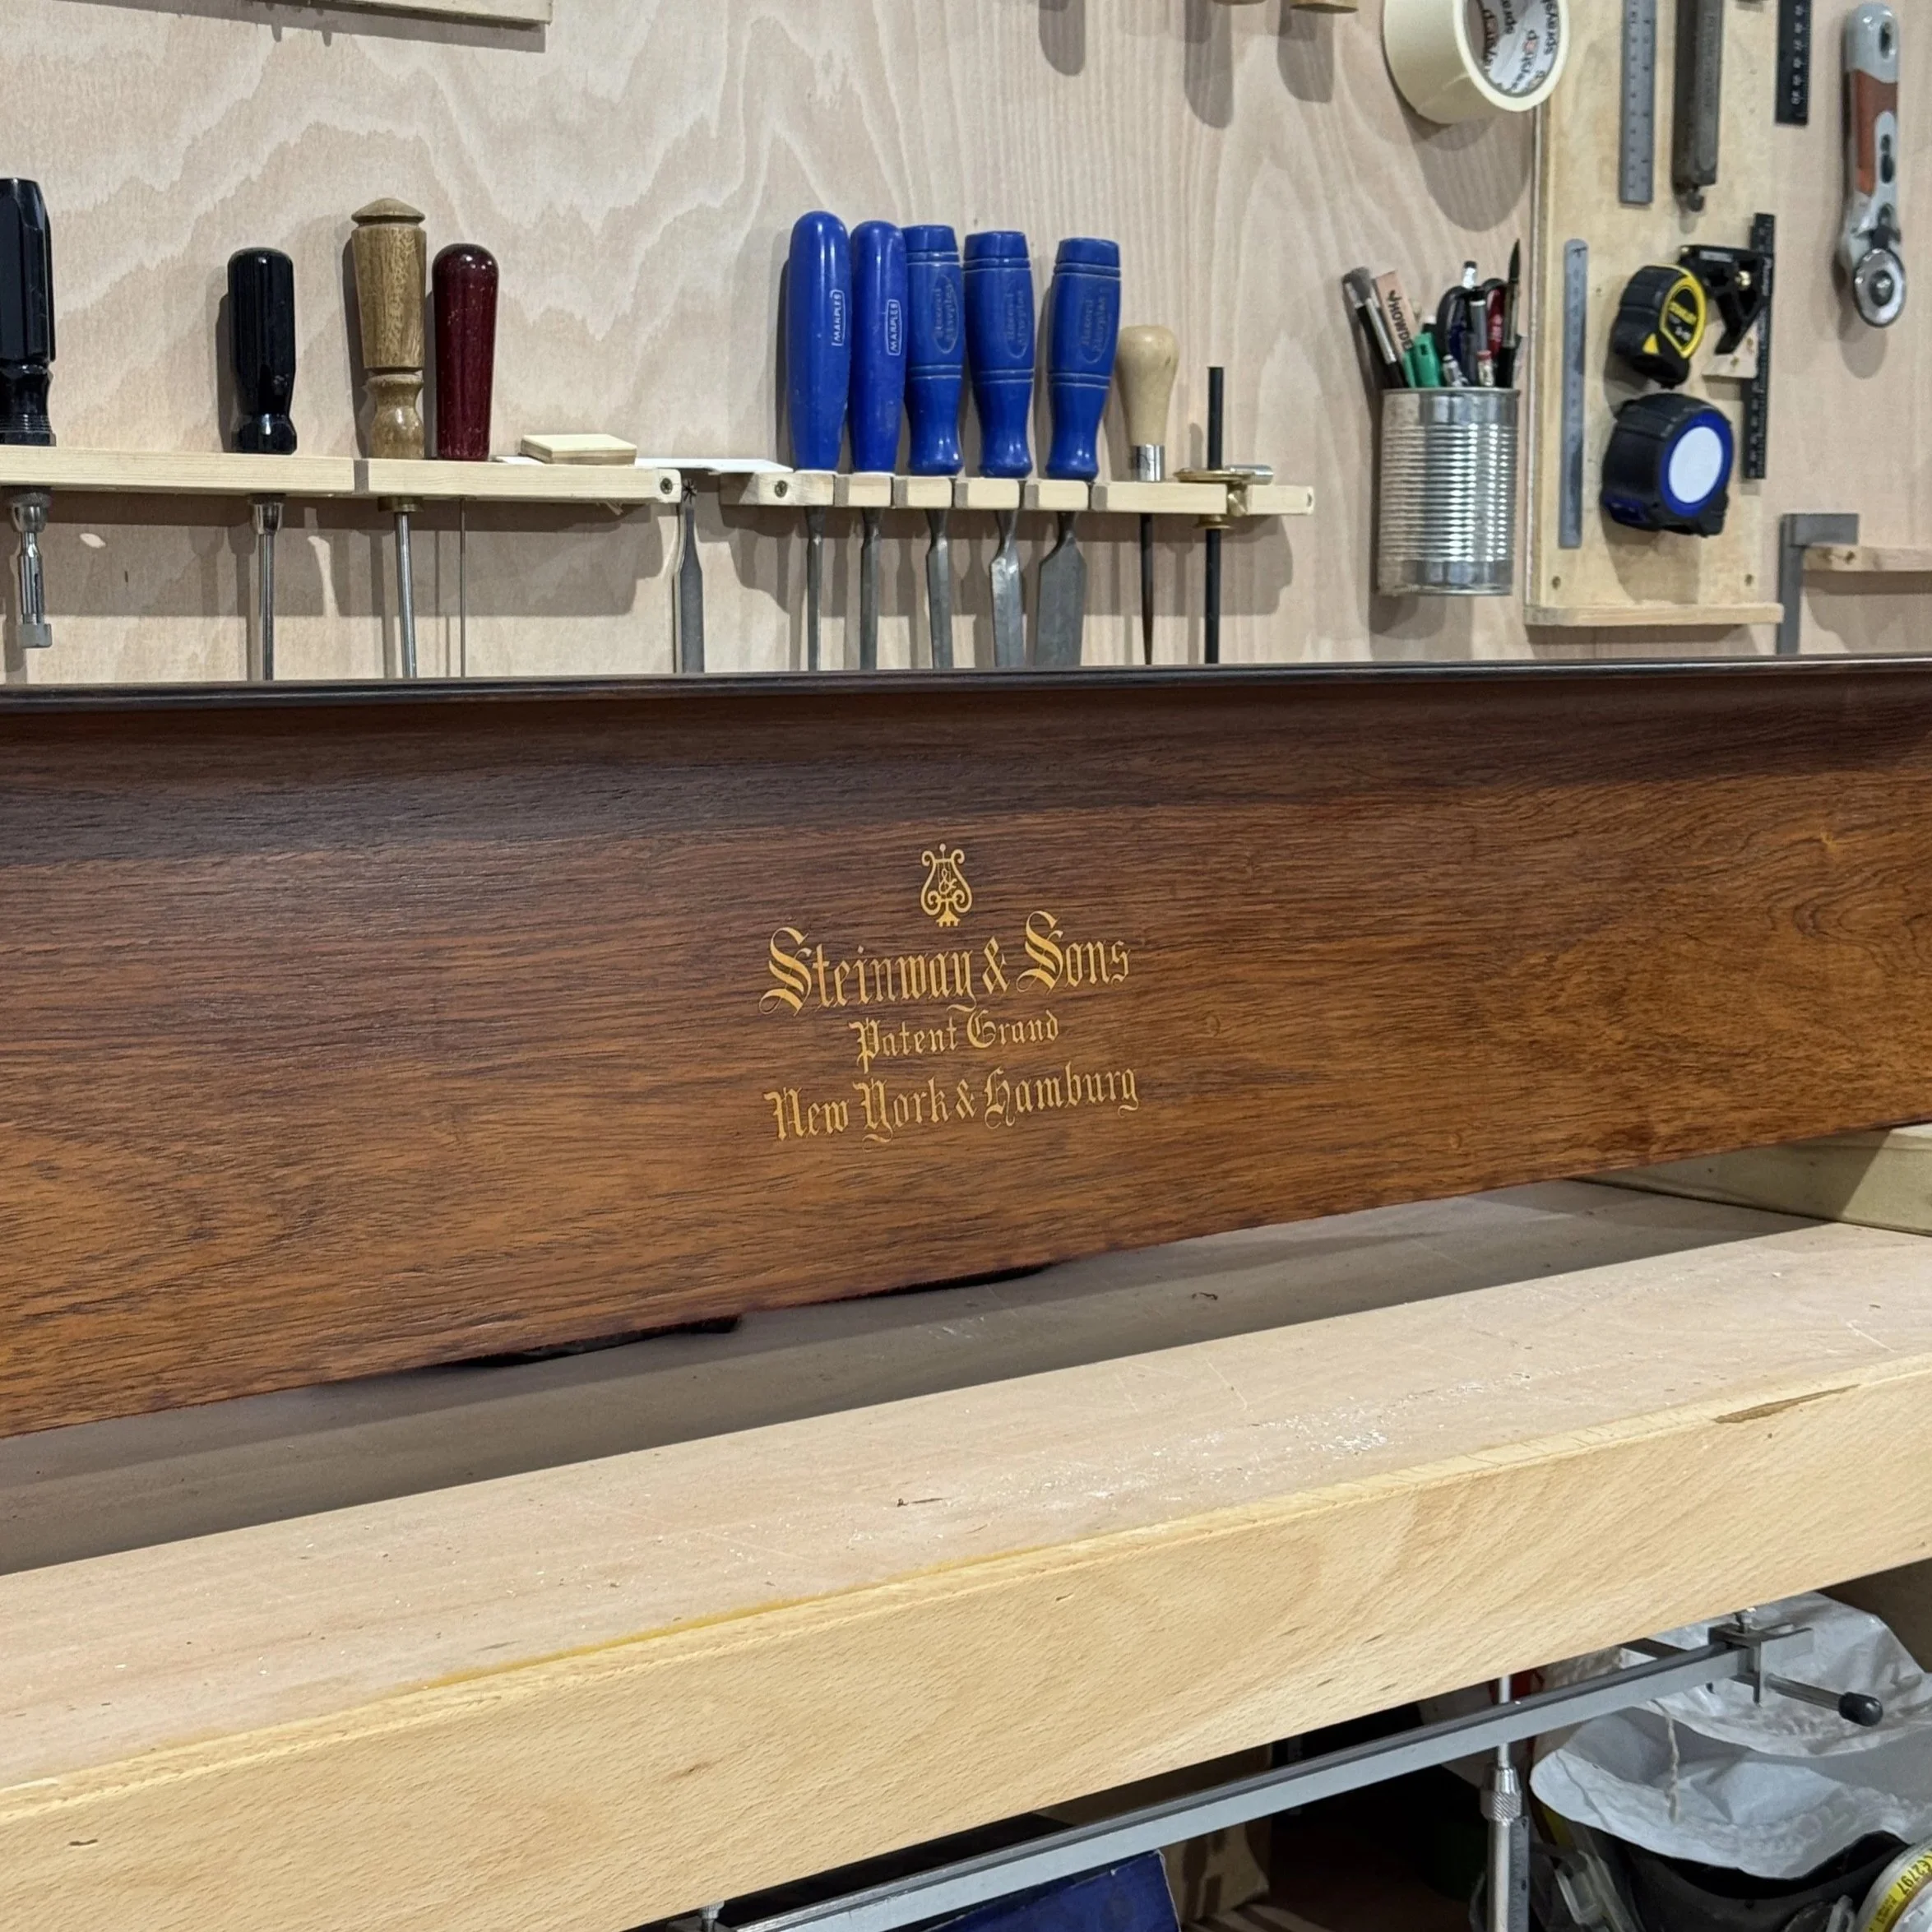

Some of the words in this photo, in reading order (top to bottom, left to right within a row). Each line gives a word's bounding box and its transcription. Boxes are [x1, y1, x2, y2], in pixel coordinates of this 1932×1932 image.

[833, 294, 842, 342] MARPLES
[889, 303, 899, 352] MARPLES
[758, 926, 978, 1017] Steinway
[982, 936, 1010, 995] &
[1017, 910, 1131, 994] Sons
[849, 1017, 958, 1073] Patent
[966, 1009, 1059, 1049] Grand
[763, 1086, 850, 1142] New
[853, 1076, 950, 1144] York
[954, 1078, 979, 1120] &
[984, 1061, 1140, 1130] Hamburg
